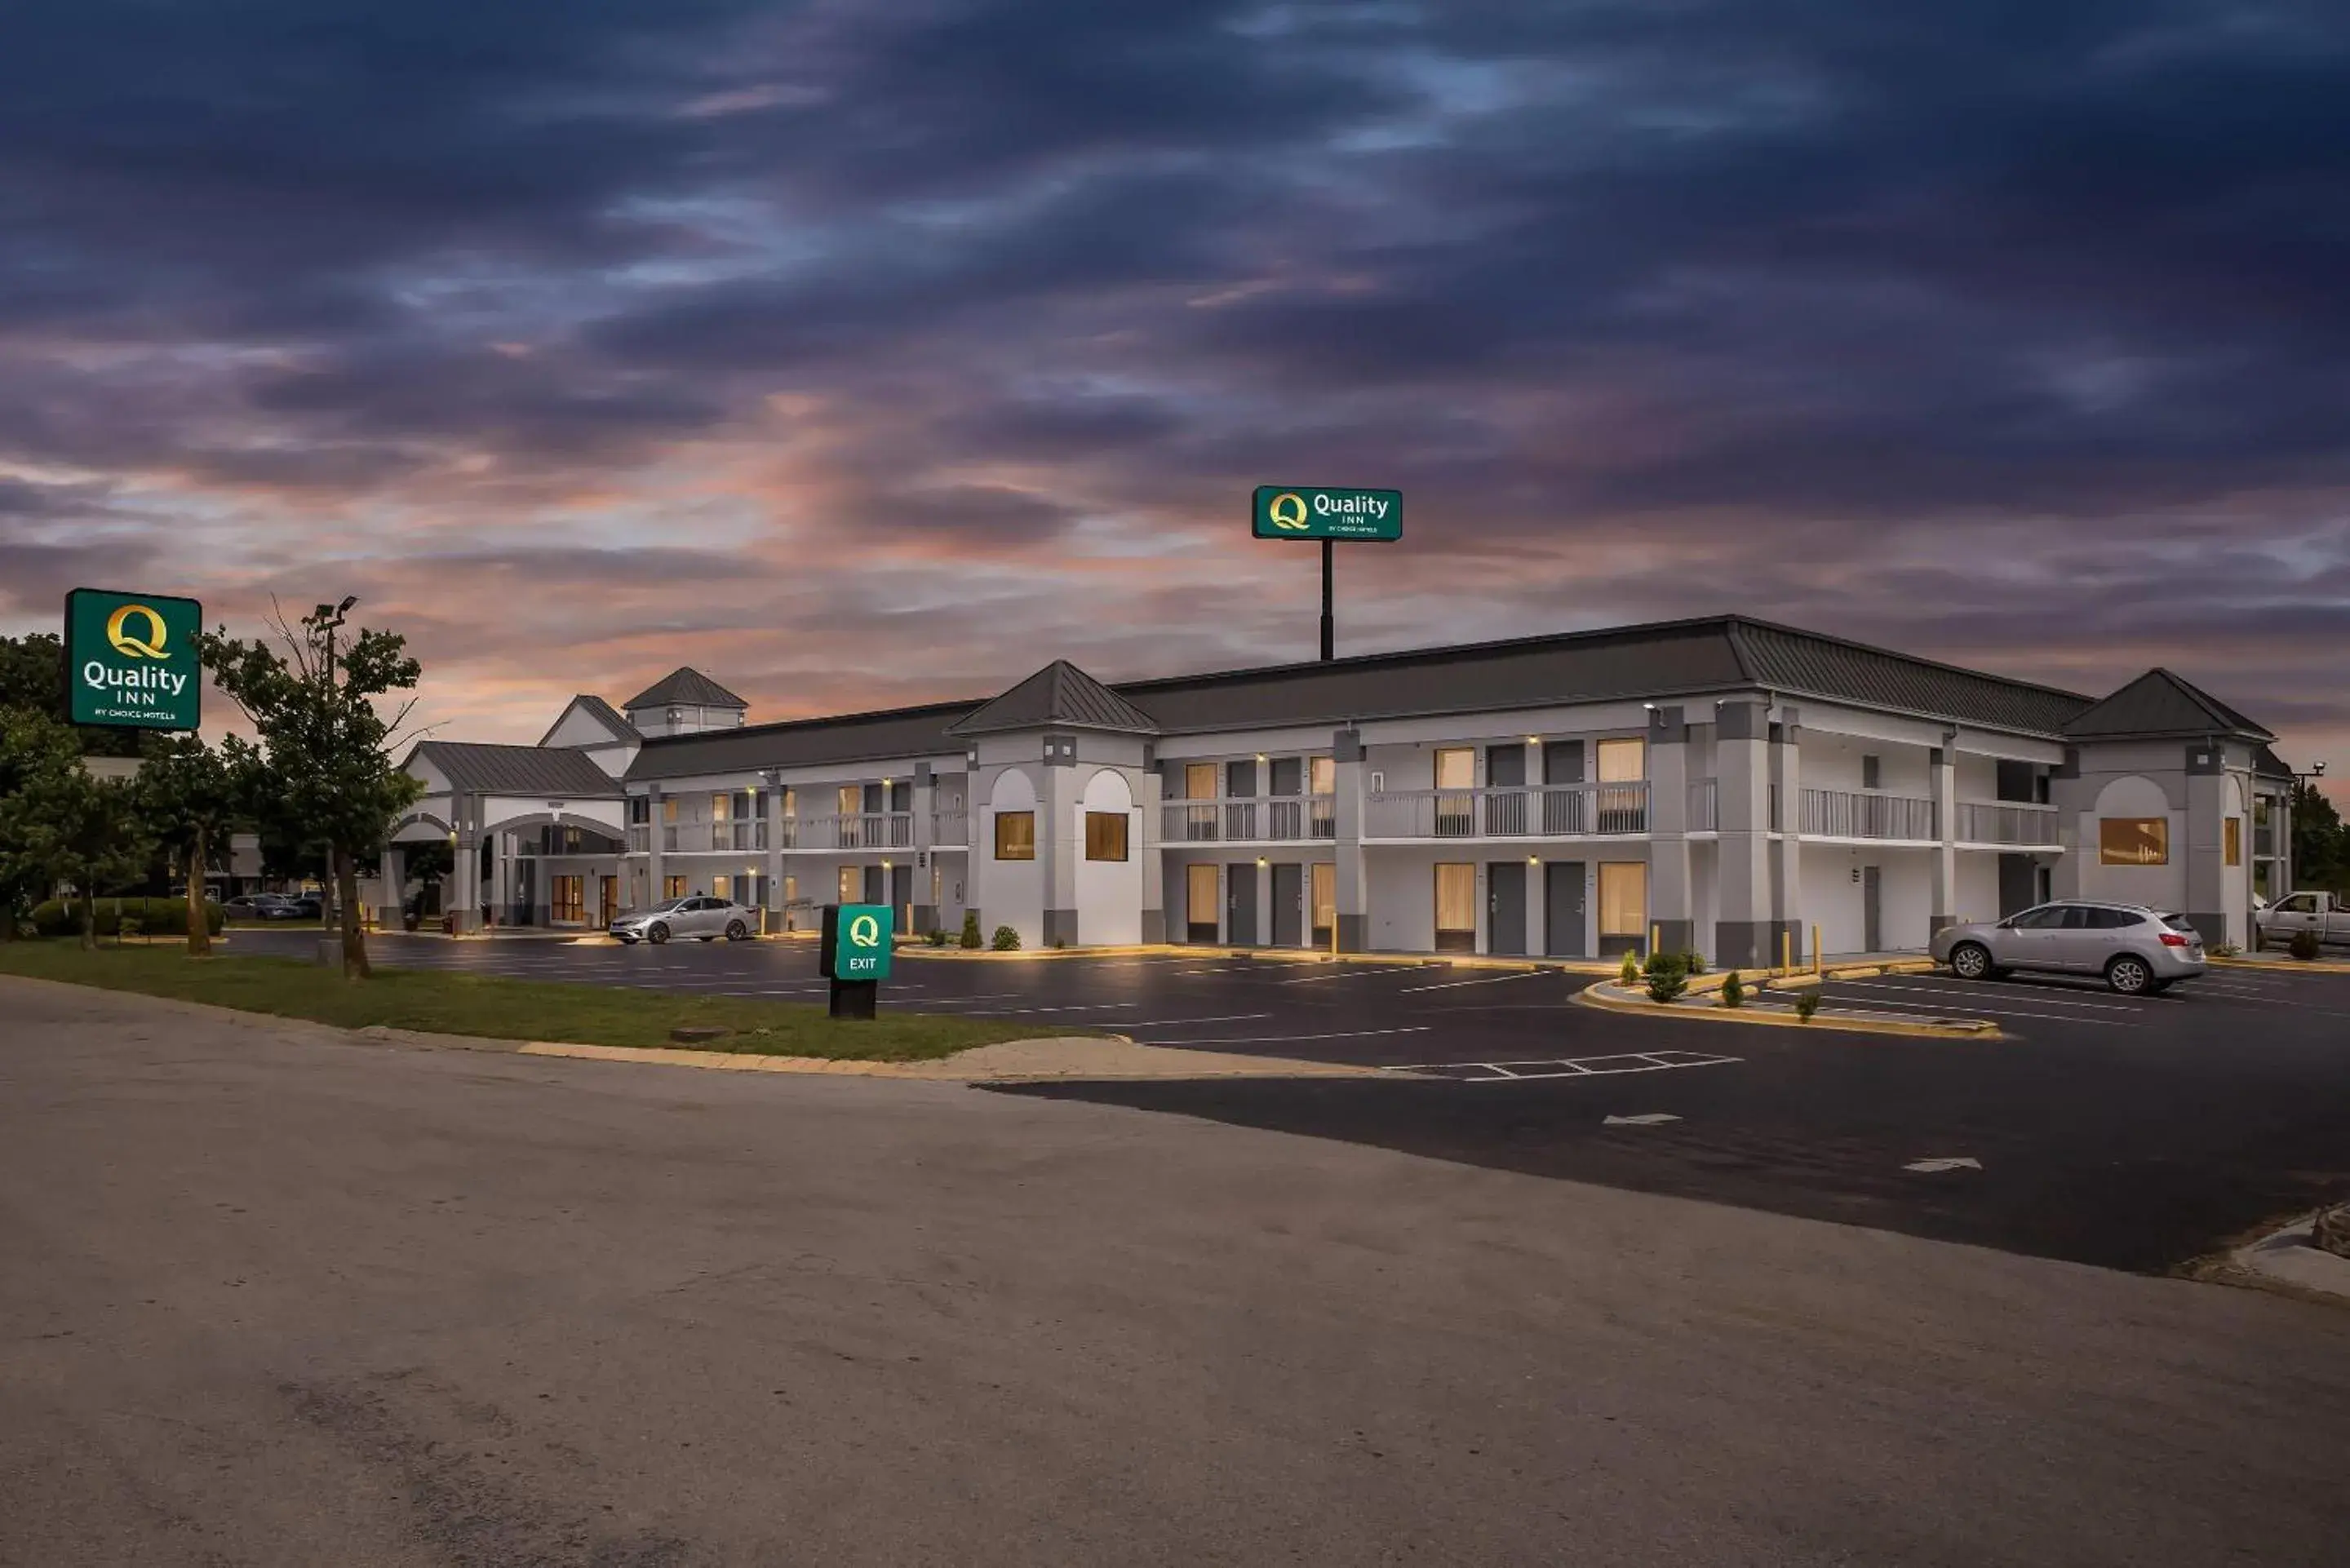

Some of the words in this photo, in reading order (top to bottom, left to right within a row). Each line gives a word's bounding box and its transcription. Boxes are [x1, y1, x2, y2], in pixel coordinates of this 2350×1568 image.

[1270, 492, 1310, 529] Q
[1314, 494, 1388, 519] Quality
[1341, 516, 1364, 525] INN
[107, 604, 171, 659] Q
[84, 661, 187, 696] Quality
[117, 690, 155, 706] INN
[109, 709, 141, 719] CHOICE
[850, 915, 880, 946] Q
[849, 958, 876, 970] EXIT
